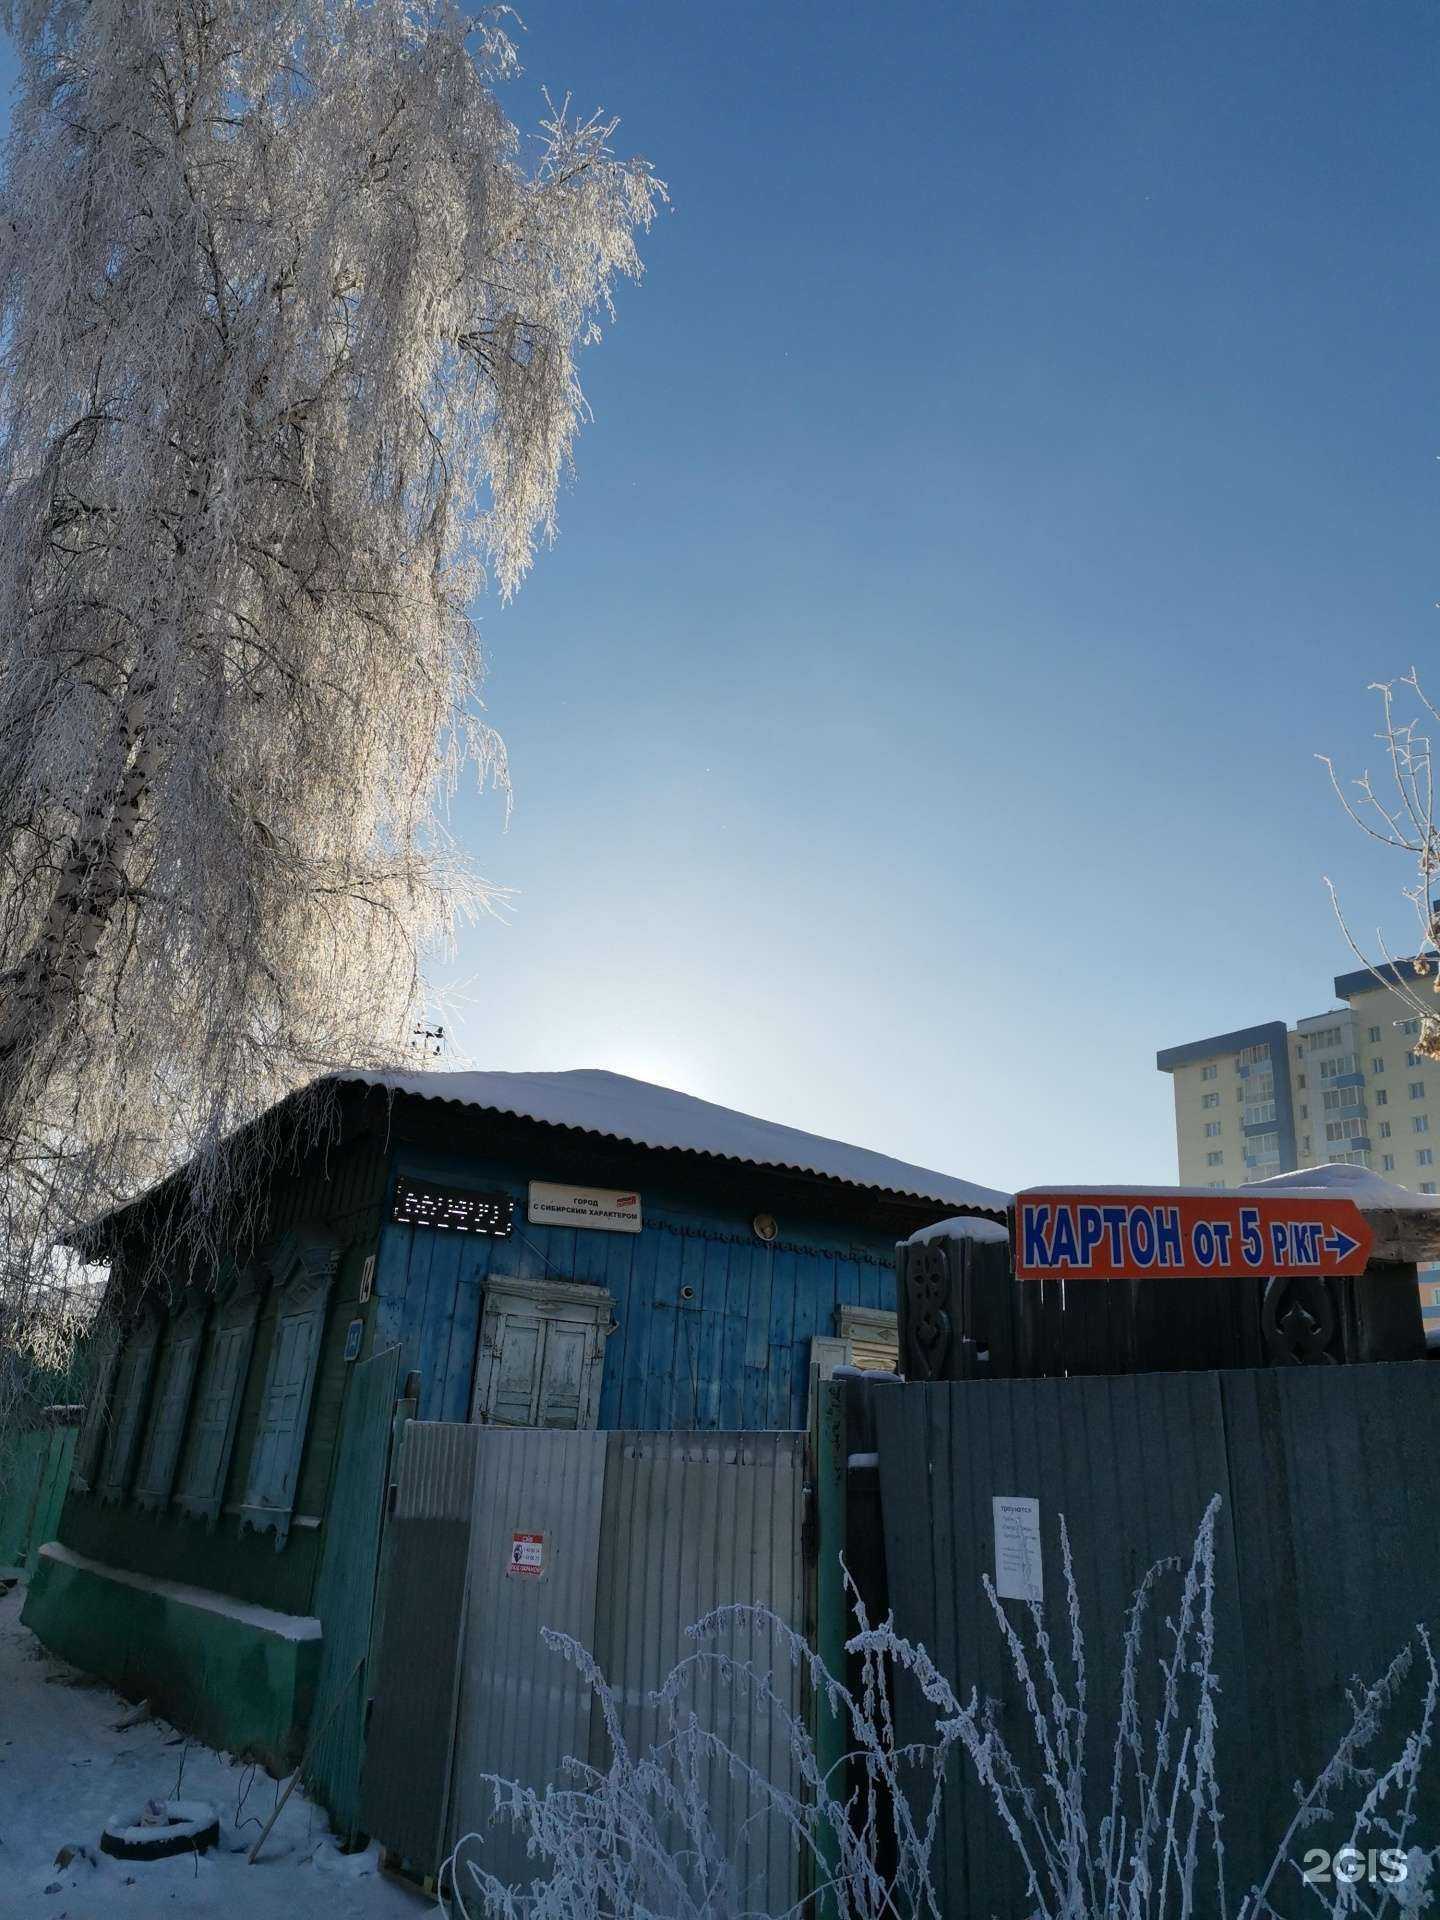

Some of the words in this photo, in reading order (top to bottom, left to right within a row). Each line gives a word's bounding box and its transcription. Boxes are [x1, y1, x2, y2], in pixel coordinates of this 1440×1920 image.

[573, 1198, 599, 1207] ГОРОД
[540, 1204, 588, 1215] СИБИРСКИМ
[589, 1210, 638, 1220] ХАРАКТЕРОМ
[1022, 1203, 1185, 1268] КАРТОН
[1239, 1207, 1263, 1268] 5
